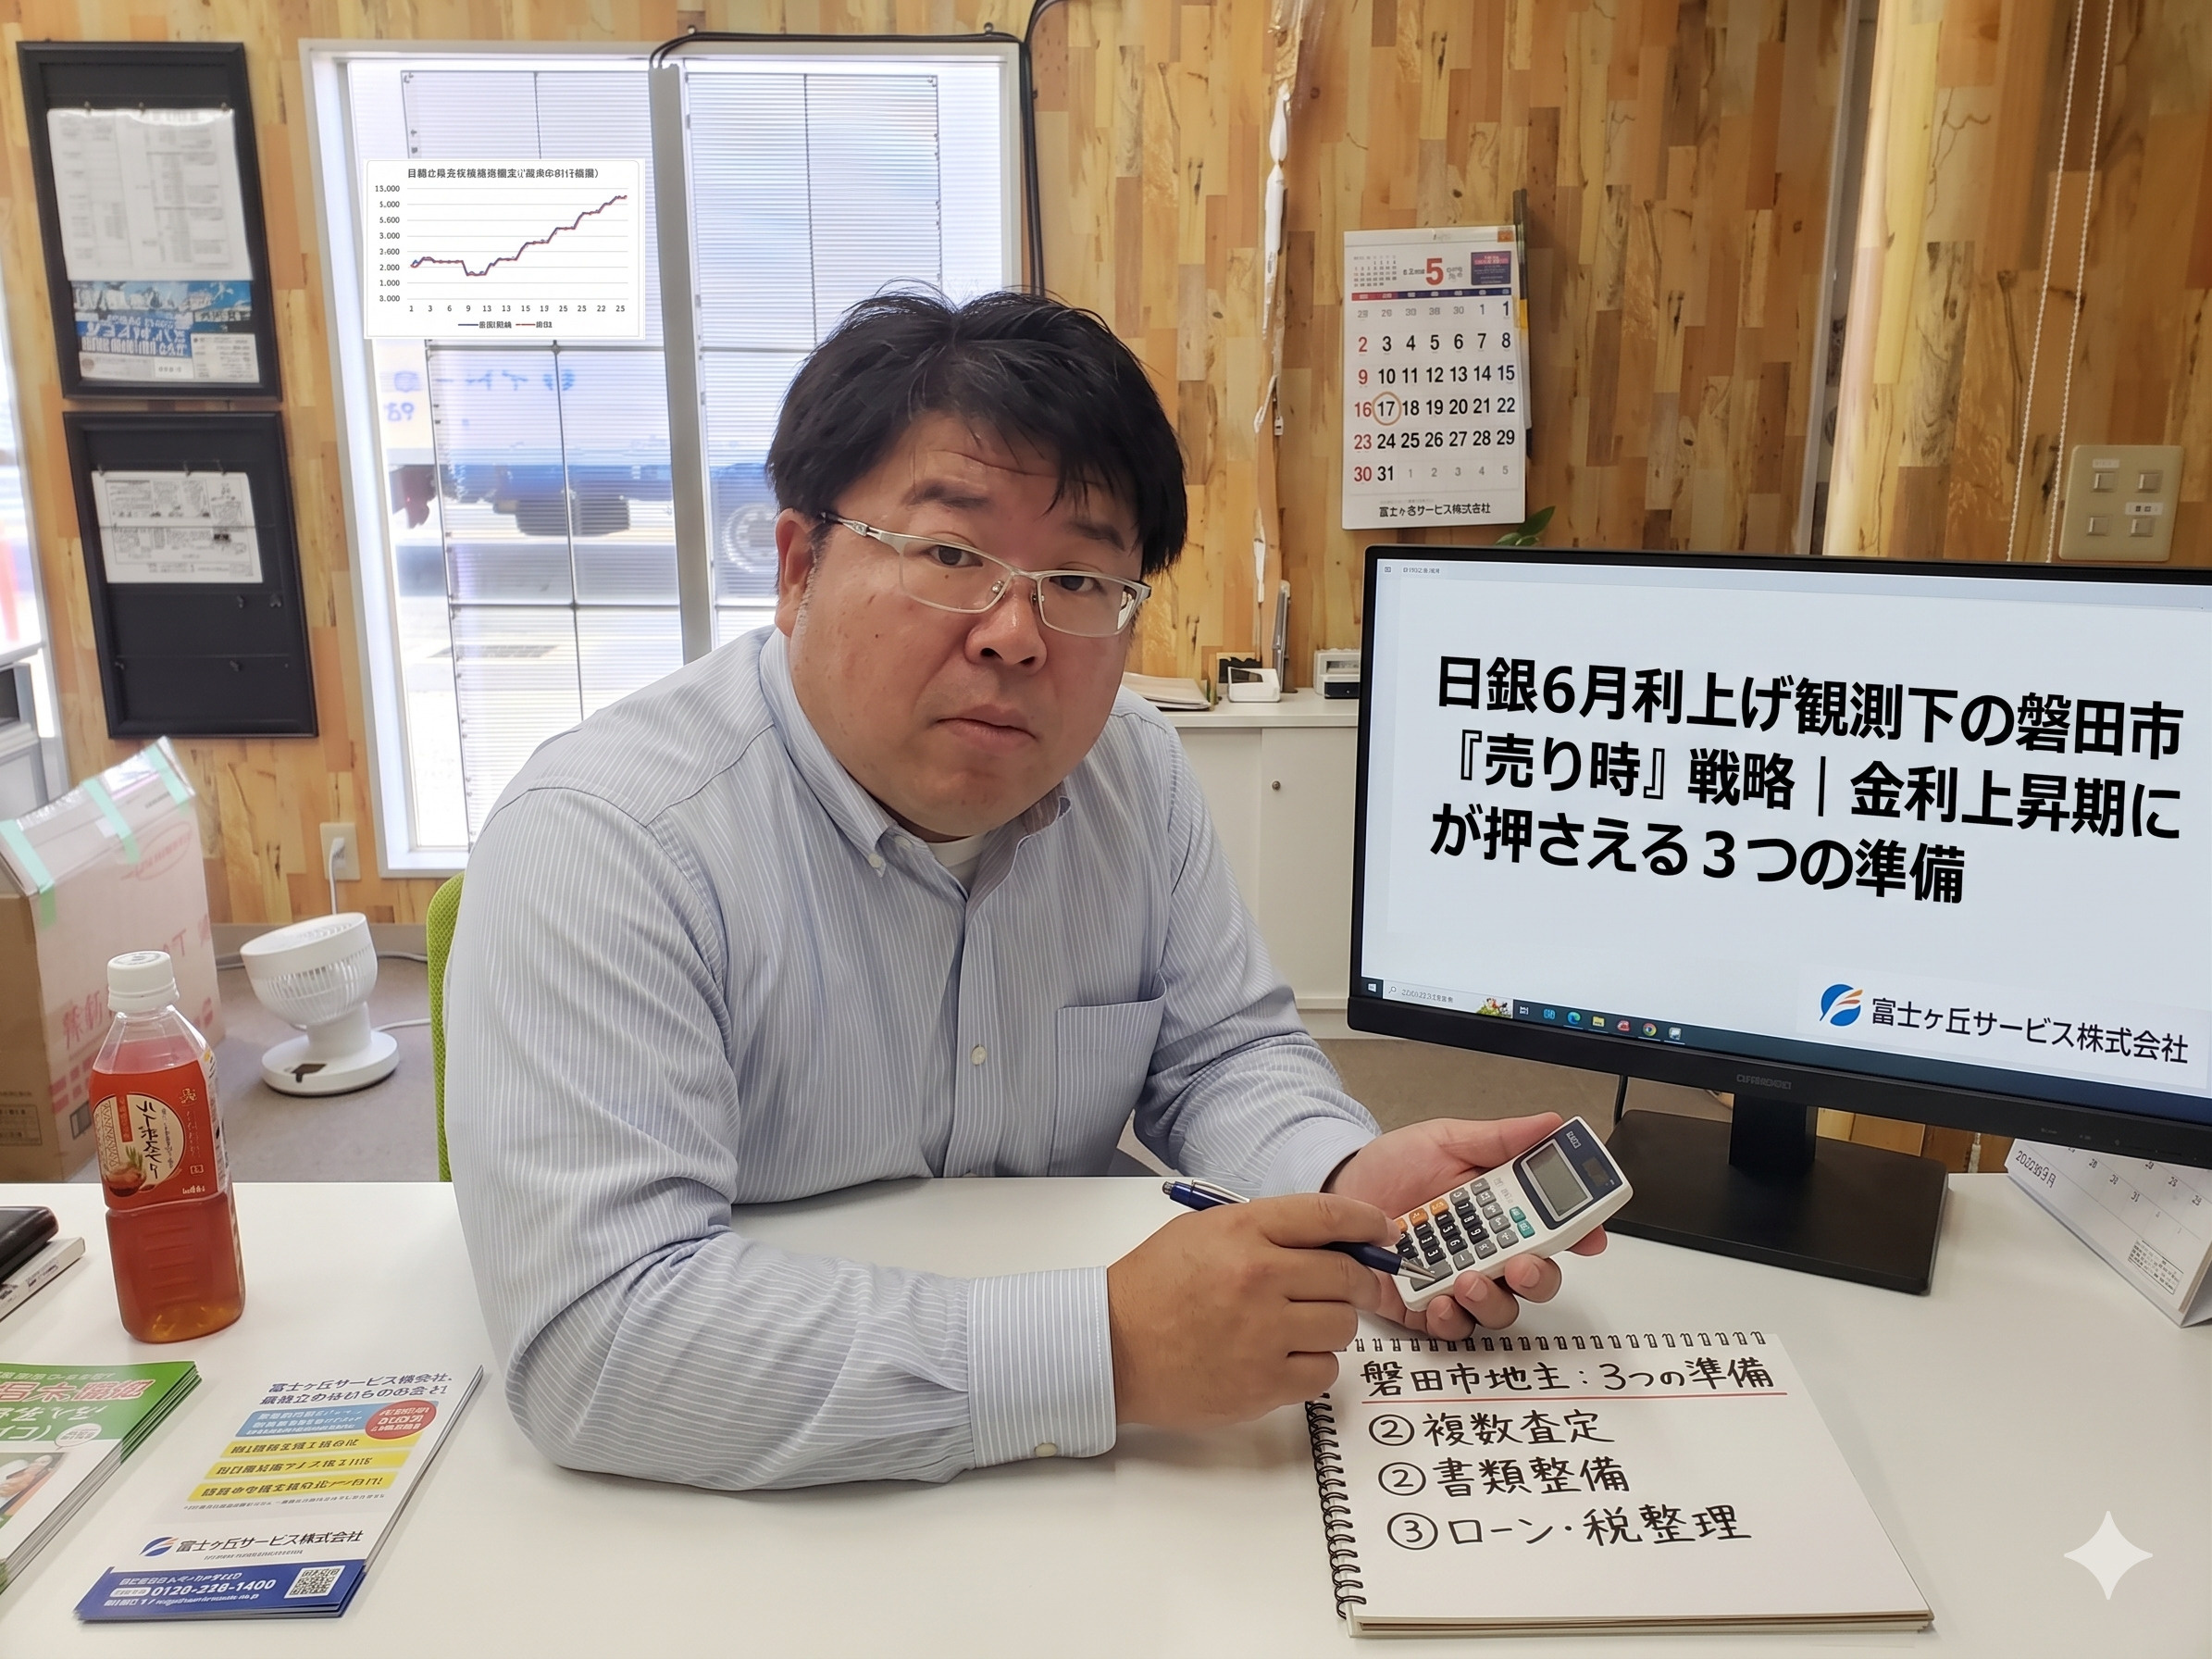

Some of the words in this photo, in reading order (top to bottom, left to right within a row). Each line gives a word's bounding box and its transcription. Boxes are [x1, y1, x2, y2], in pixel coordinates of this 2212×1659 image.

[1425, 257, 1444, 286] 5
[1502, 300, 1509, 317] 1
[1358, 336, 1368, 353] 2
[1382, 335, 1392, 352] 3
[1405, 334, 1416, 351] 4
[1430, 334, 1440, 351] 5
[1453, 333, 1464, 350] 6
[1477, 332, 1487, 349] 7
[1501, 331, 1511, 349] 8
[1358, 368, 1368, 385] 9
[1378, 368, 1396, 384] 10
[1401, 367, 1418, 384] 11
[1425, 367, 1444, 383] 12
[1449, 366, 1468, 382] 13
[1473, 365, 1492, 381] 14
[1497, 364, 1515, 381] 15
[1354, 401, 1374, 418] 16
[1377, 400, 1396, 417] 17
[1401, 399, 1420, 417] 18
[1425, 399, 1444, 416] 19
[1448, 398, 1469, 415] 20
[1473, 397, 1490, 414] 21
[1497, 396, 1516, 413] 22
[1353, 433, 1373, 450] 23
[1377, 432, 1397, 450] 24
[1400, 431, 1421, 449] 25
[1424, 431, 1444, 448] 26
[1448, 430, 1468, 447] 27
[1473, 430, 1492, 446] 28
[1497, 429, 1515, 445] 29
[1353, 466, 1373, 482] 30
[1377, 465, 1394, 481] 31
[1438, 655, 2184, 762] 日銀6月利上げ観測下の磐田市
